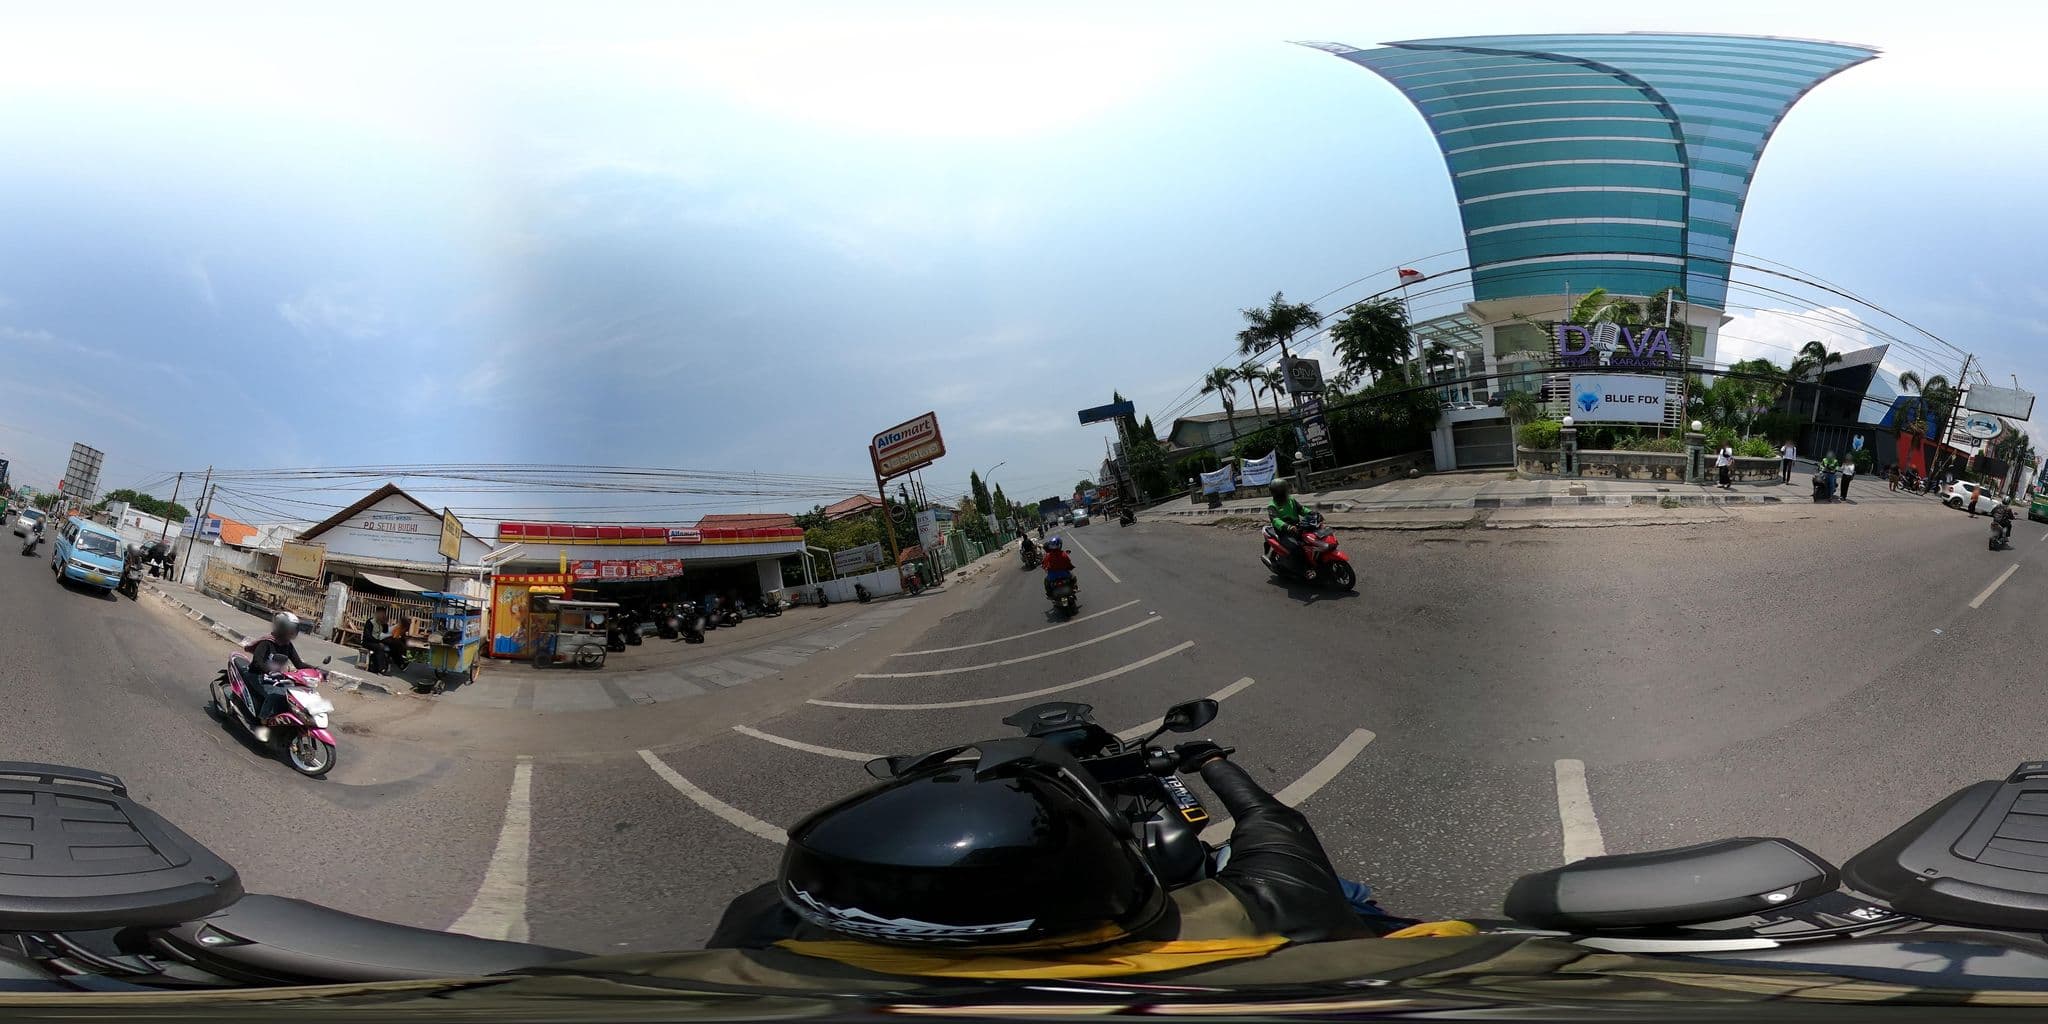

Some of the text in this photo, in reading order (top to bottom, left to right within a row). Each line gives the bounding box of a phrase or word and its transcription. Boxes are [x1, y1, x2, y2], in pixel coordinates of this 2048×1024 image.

[1604, 394, 1659, 405] BLUE FOX
[878, 420, 931, 448] Alfamart
